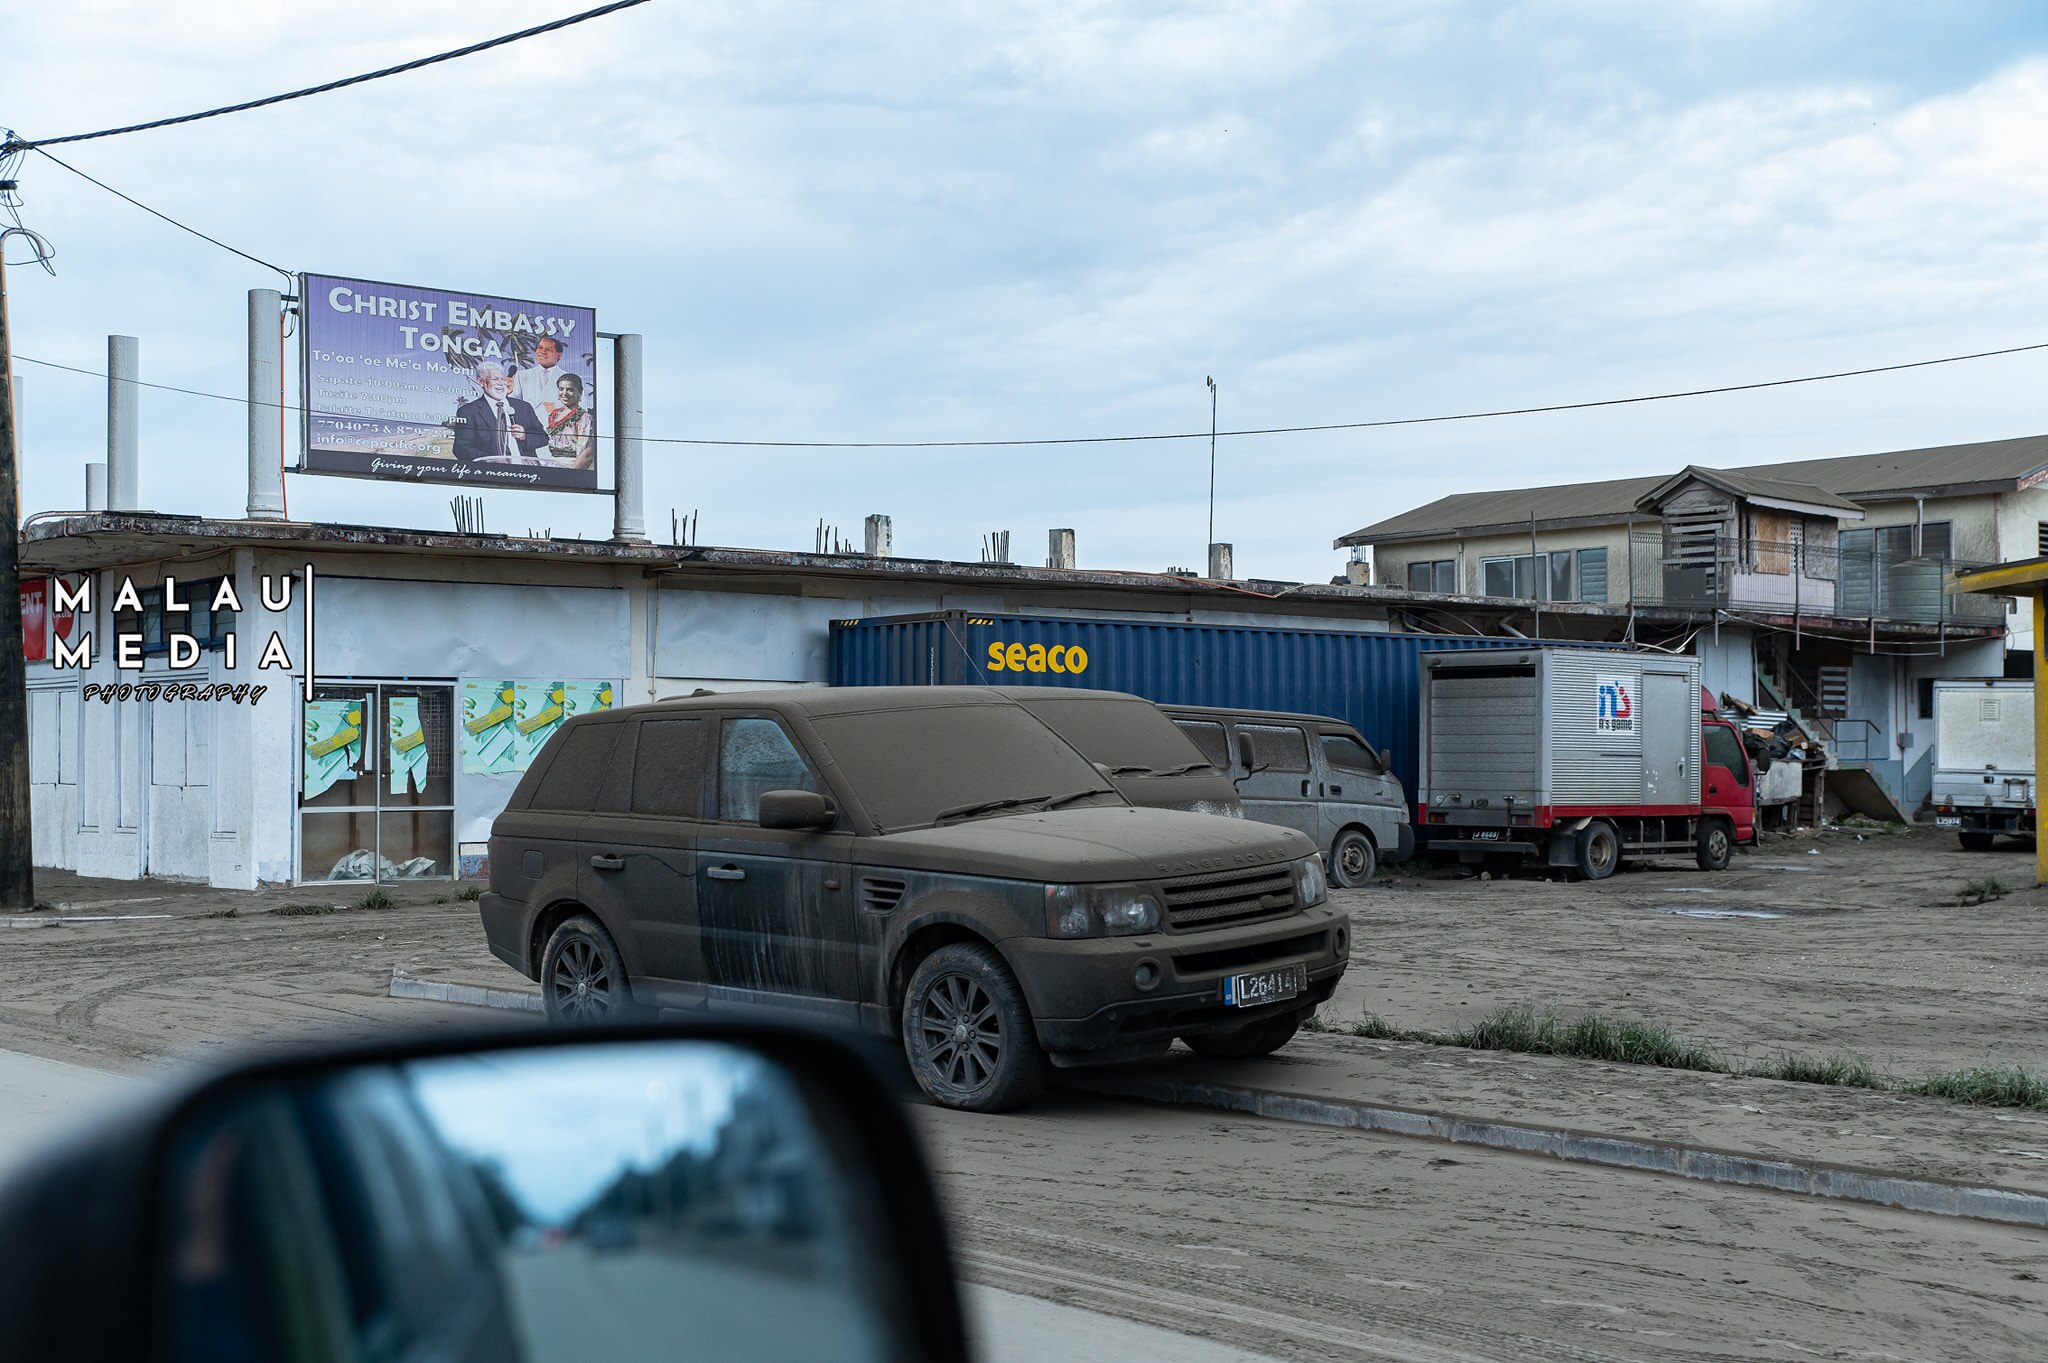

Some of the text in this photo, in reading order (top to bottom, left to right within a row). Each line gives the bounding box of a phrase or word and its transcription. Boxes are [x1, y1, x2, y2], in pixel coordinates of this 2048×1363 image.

[328, 286, 576, 338] CHRIST EMBASSY
[400, 326, 503, 359] TONGA
[383, 425, 391, 434] &
[371, 457, 412, 474] Giving
[417, 464, 447, 477] your
[451, 463, 471, 479] life
[987, 641, 1088, 674] seaco
[1157, 848, 1287, 873] RANGE ROVER
